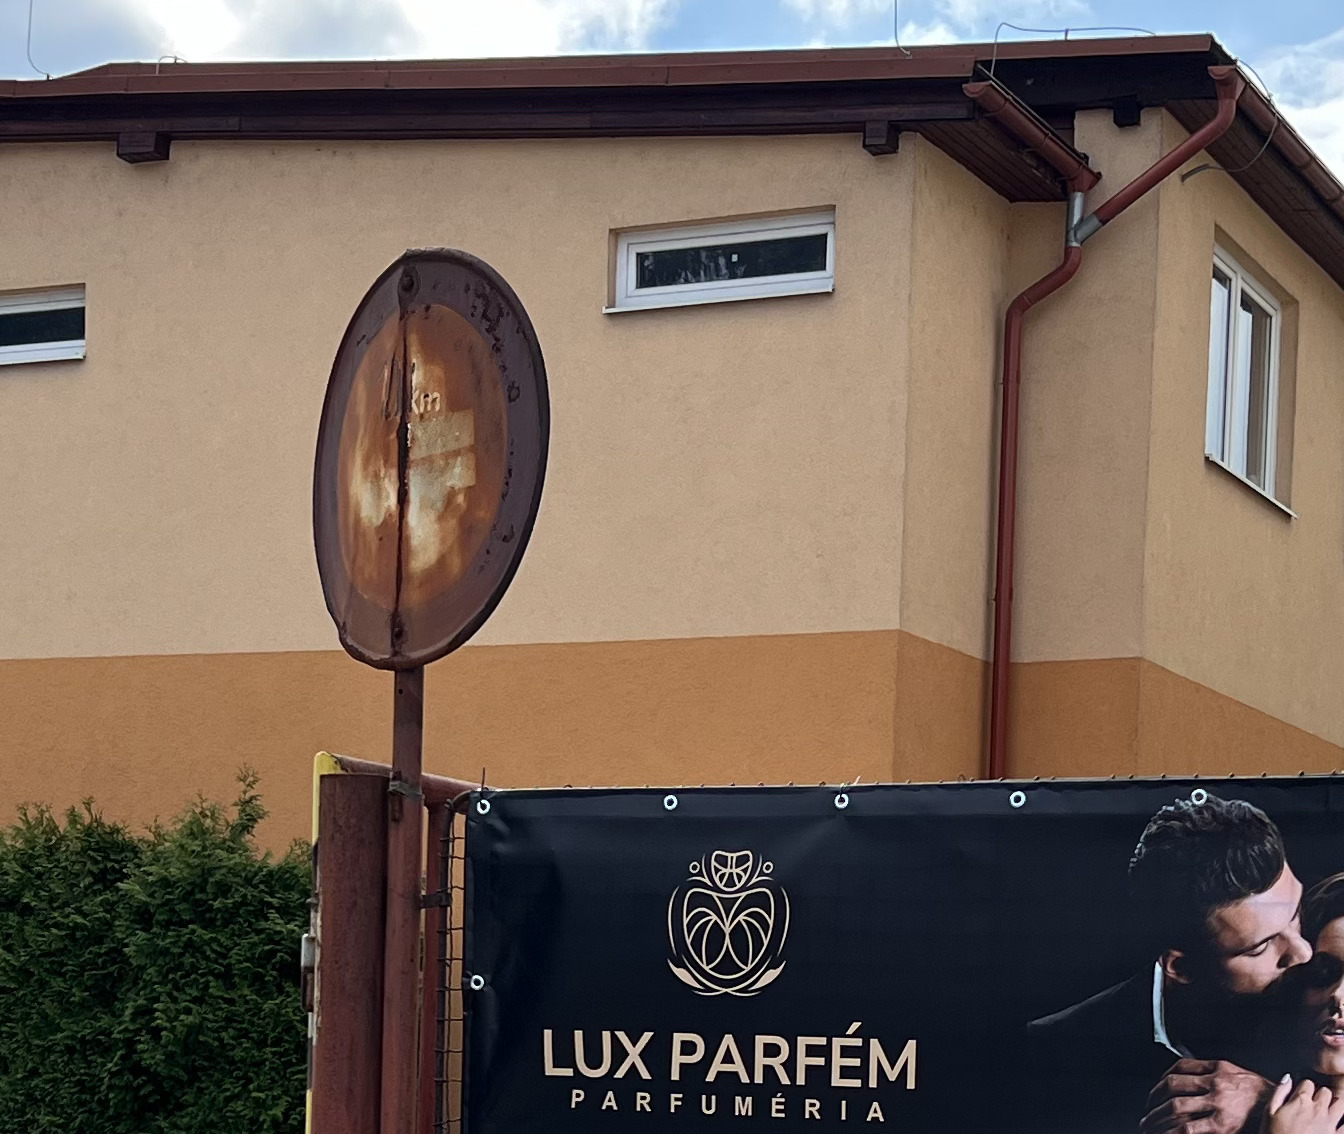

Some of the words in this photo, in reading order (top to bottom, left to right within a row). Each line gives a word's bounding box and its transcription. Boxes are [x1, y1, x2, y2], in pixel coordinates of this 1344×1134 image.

[543, 1029, 654, 1079] LUX
[670, 1022, 917, 1089] PARFÉM
[571, 1089, 884, 1122] PARFUMÉRIA
